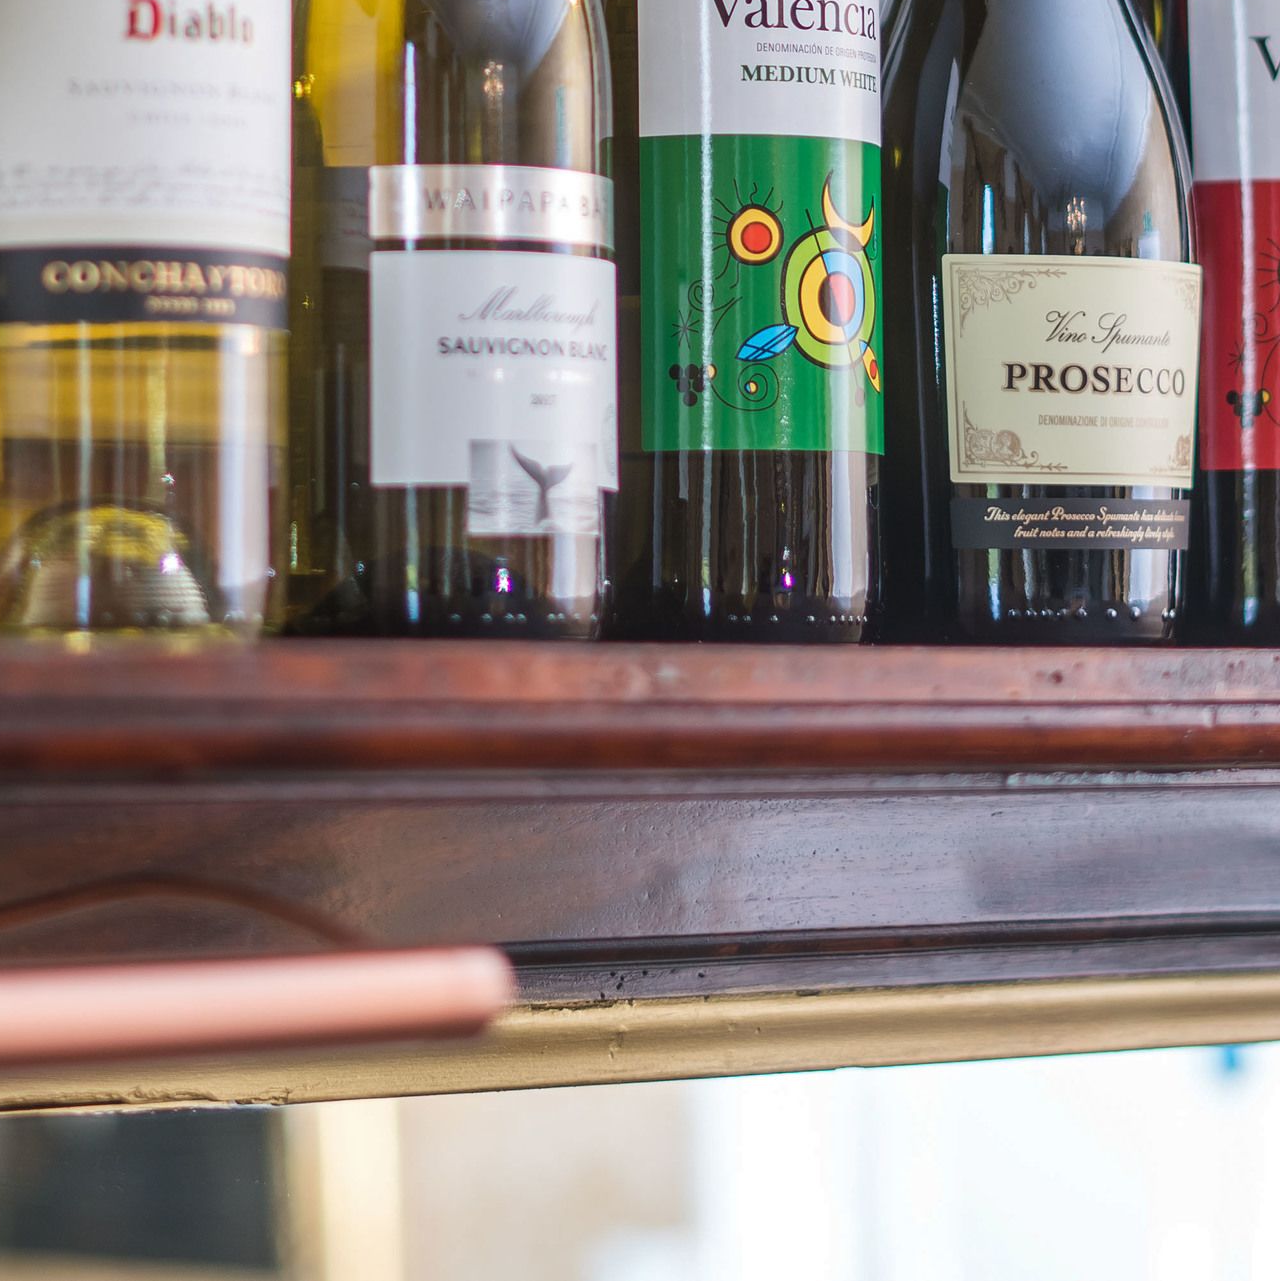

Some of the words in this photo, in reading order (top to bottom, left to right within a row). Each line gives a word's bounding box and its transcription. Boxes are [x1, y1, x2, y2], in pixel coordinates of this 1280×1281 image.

[756, 40, 823, 56] DENOMINACIÓN
[740, 64, 836, 85] MEDIUM
[839, 70, 877, 94] WHITE
[456, 284, 602, 333] Marlborough
[1045, 310, 1087, 343] Vino
[1091, 311, 1171, 354] Spumante
[437, 336, 565, 357] SAUVIGNON
[1001, 362, 1186, 397] PROSECCO
[983, 506, 1011, 522] This
[1011, 509, 1050, 525] elegant
[1051, 506, 1096, 522] Prosecco
[1097, 506, 1140, 525] Spumante
[1013, 526, 1039, 539] fruit
[1039, 527, 1065, 538] notes
[1066, 526, 1087, 538] and
[1095, 525, 1145, 543] refreshingly
